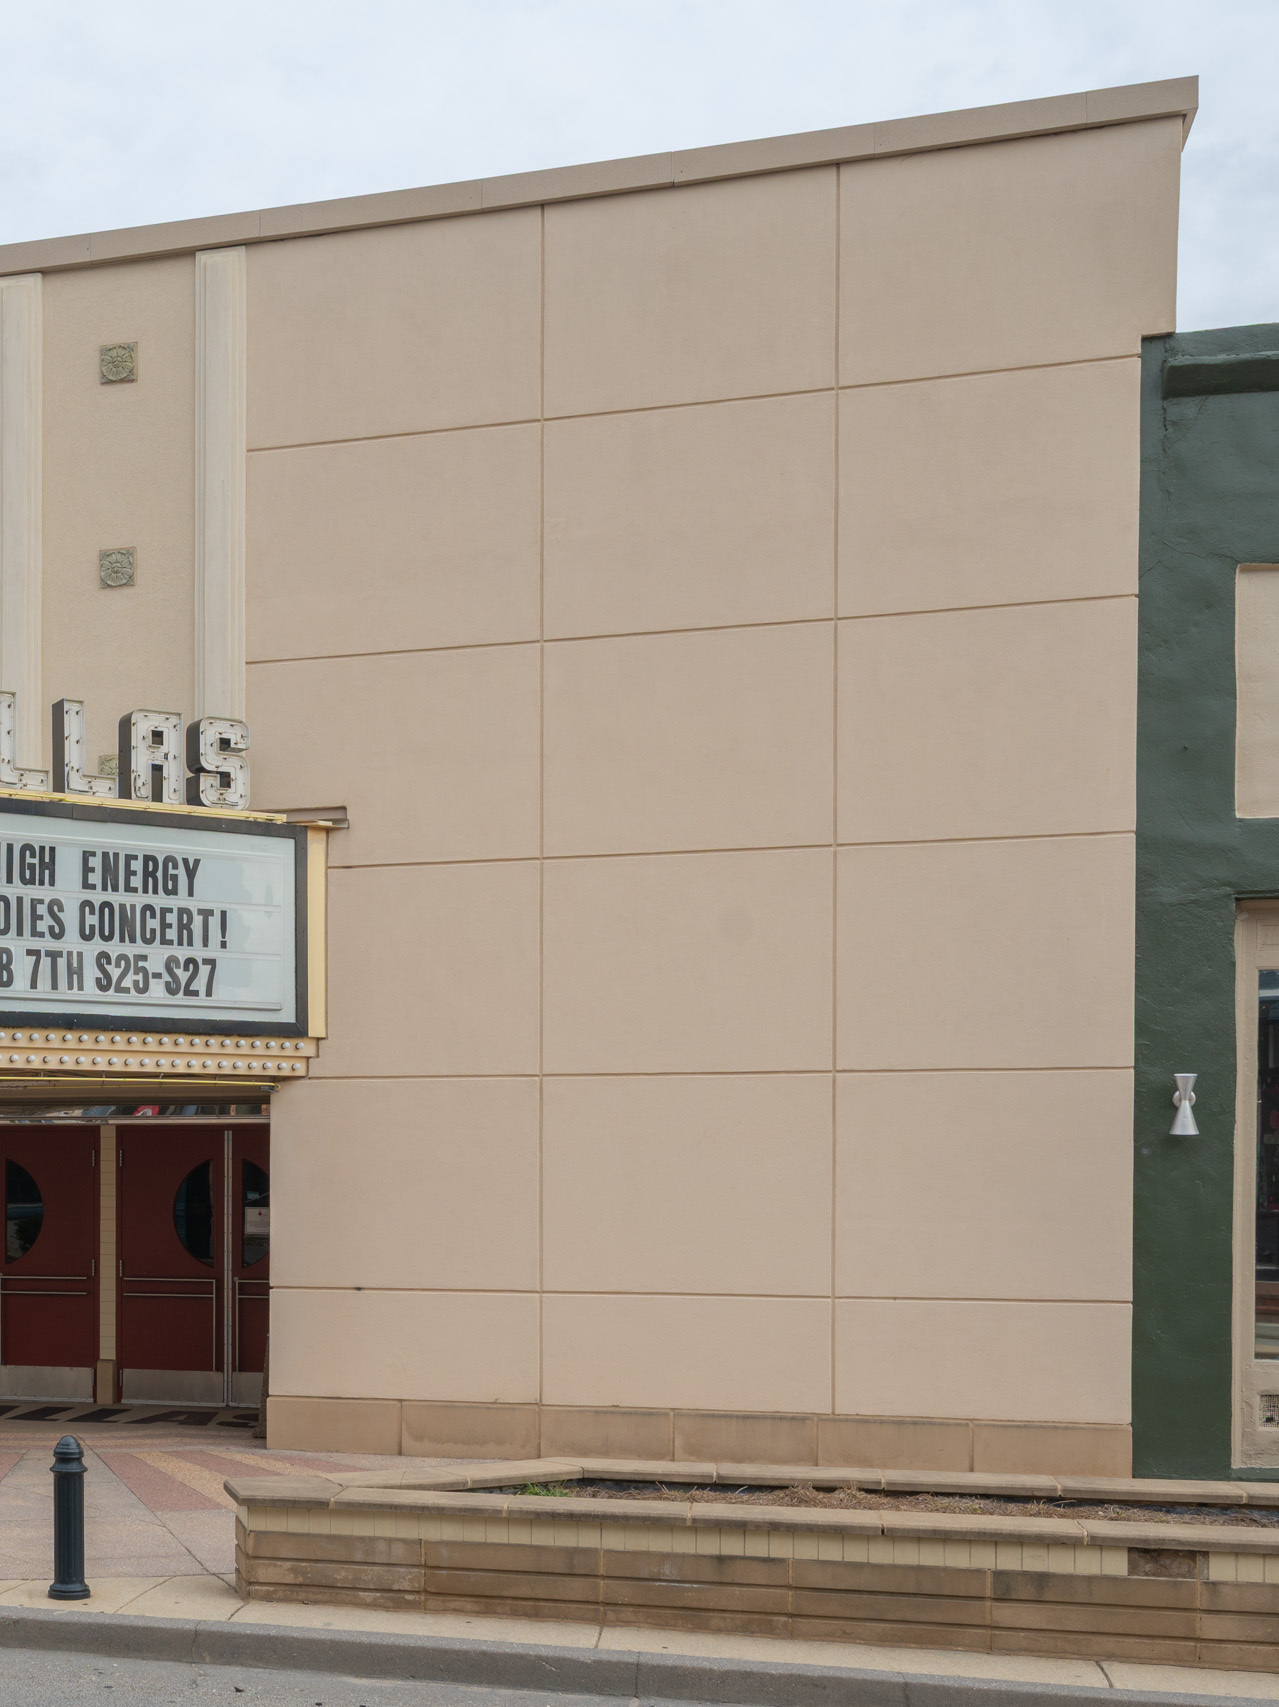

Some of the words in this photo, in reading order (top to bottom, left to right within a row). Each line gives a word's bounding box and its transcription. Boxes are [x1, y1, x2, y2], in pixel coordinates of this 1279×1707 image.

[81, 850, 202, 898] ENERGY
[78, 899, 228, 950] CONCERT!
[25, 948, 85, 992] 7TH
[95, 950, 217, 998] $25-$27
